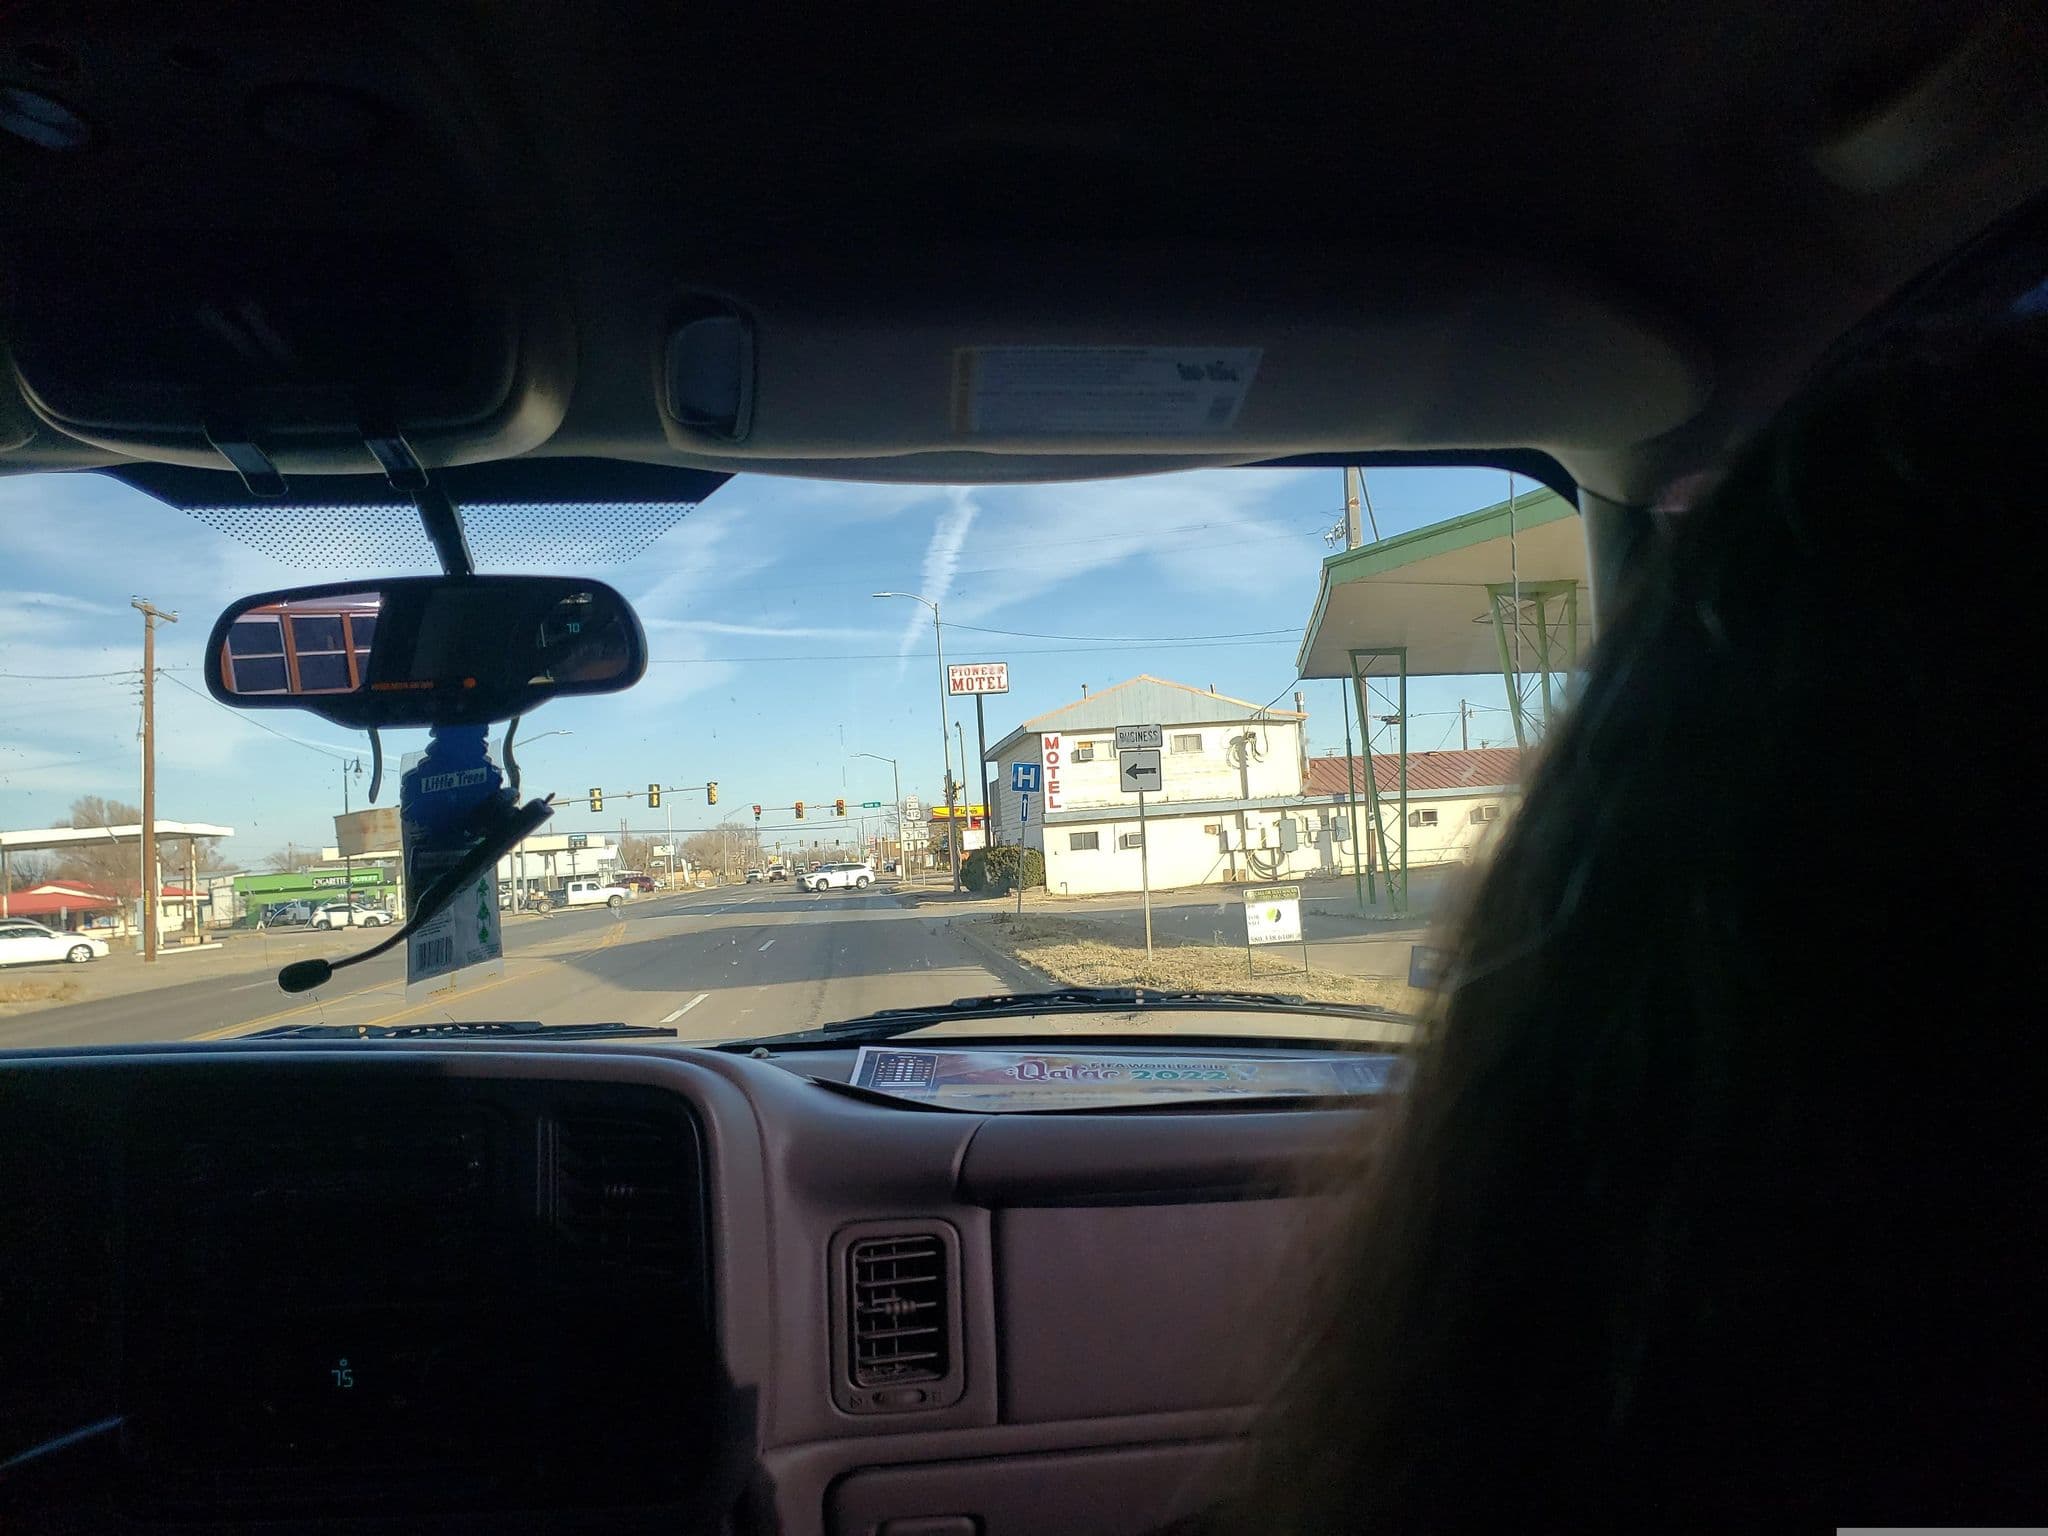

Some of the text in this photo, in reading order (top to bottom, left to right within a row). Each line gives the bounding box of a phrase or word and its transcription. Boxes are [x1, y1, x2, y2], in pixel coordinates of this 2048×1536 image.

[951, 665, 1005, 676] PIONEER
[951, 676, 1006, 691] MOTEL
[1119, 730, 1158, 743] BUSINESS
[1017, 766, 1035, 789] H
[1044, 736, 1062, 809] MOTEL
[424, 773, 454, 791] Little
[1015, 1060, 1230, 1081] Qatar 2022
